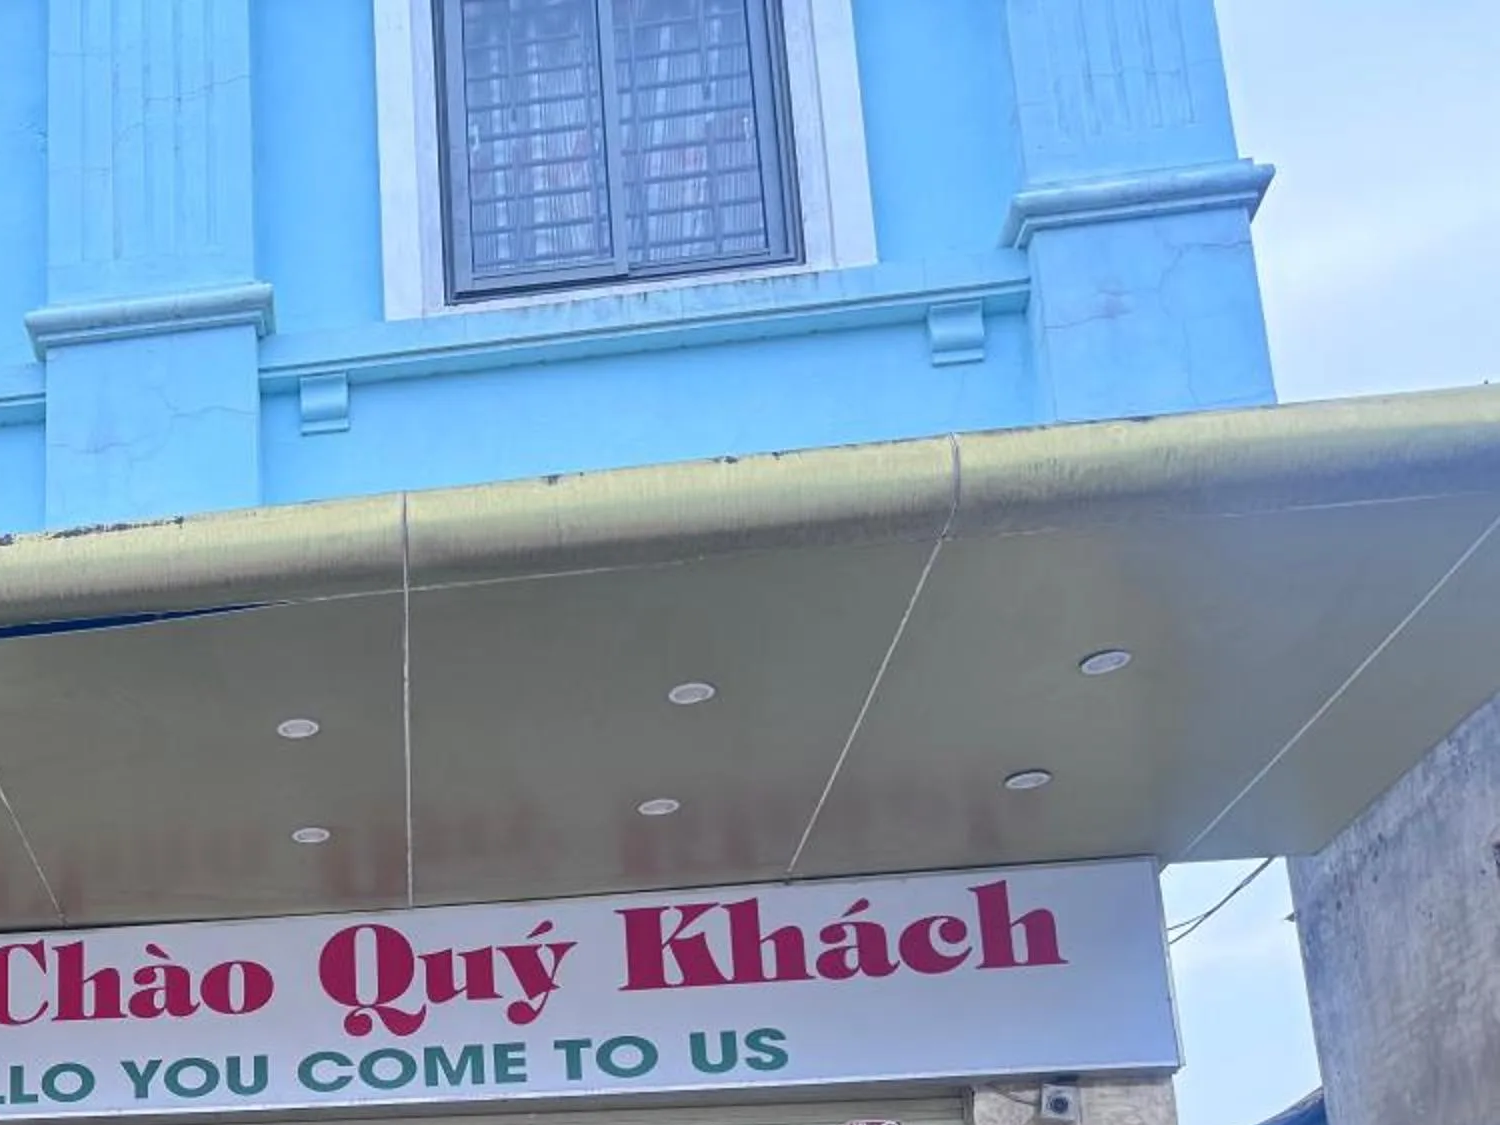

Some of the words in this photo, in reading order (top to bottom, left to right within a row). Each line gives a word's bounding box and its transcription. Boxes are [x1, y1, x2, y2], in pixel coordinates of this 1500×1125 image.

[317, 921, 578, 1038] Quý
[615, 880, 1068, 993] Khách
[120, 1054, 269, 1100] YOU
[297, 1041, 528, 1093] COME
[553, 1035, 660, 1081] TO
[688, 1027, 790, 1075] US
